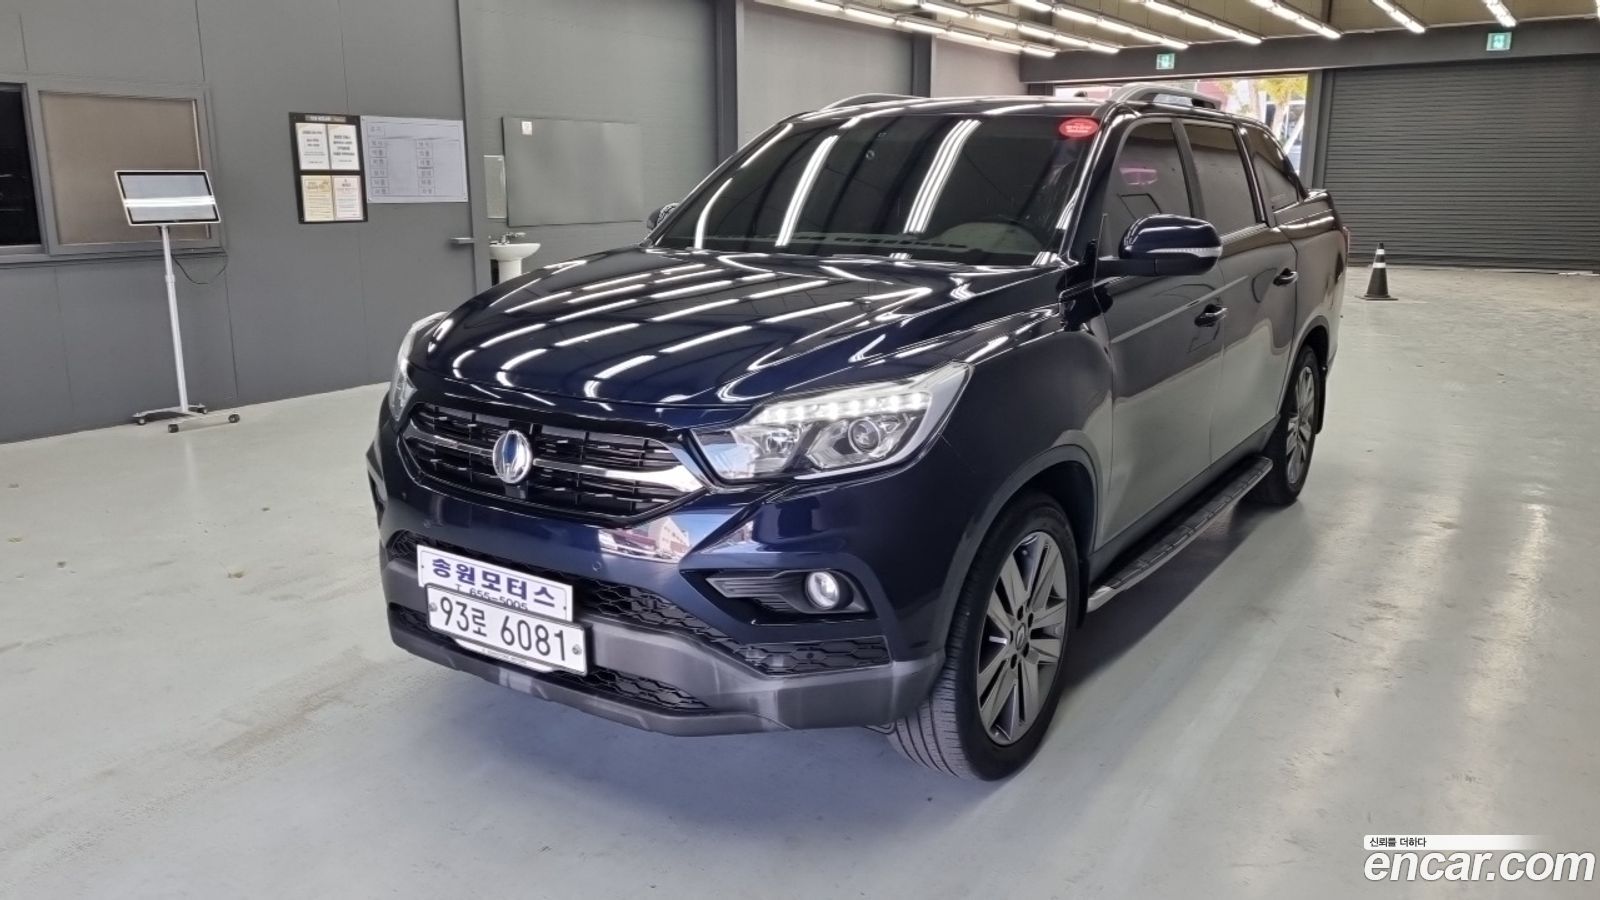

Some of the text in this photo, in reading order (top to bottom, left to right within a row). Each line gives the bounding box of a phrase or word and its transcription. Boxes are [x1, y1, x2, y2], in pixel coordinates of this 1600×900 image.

[432, 558, 556, 608] 송원모터스
[440, 596, 566, 662] 93로 6081
